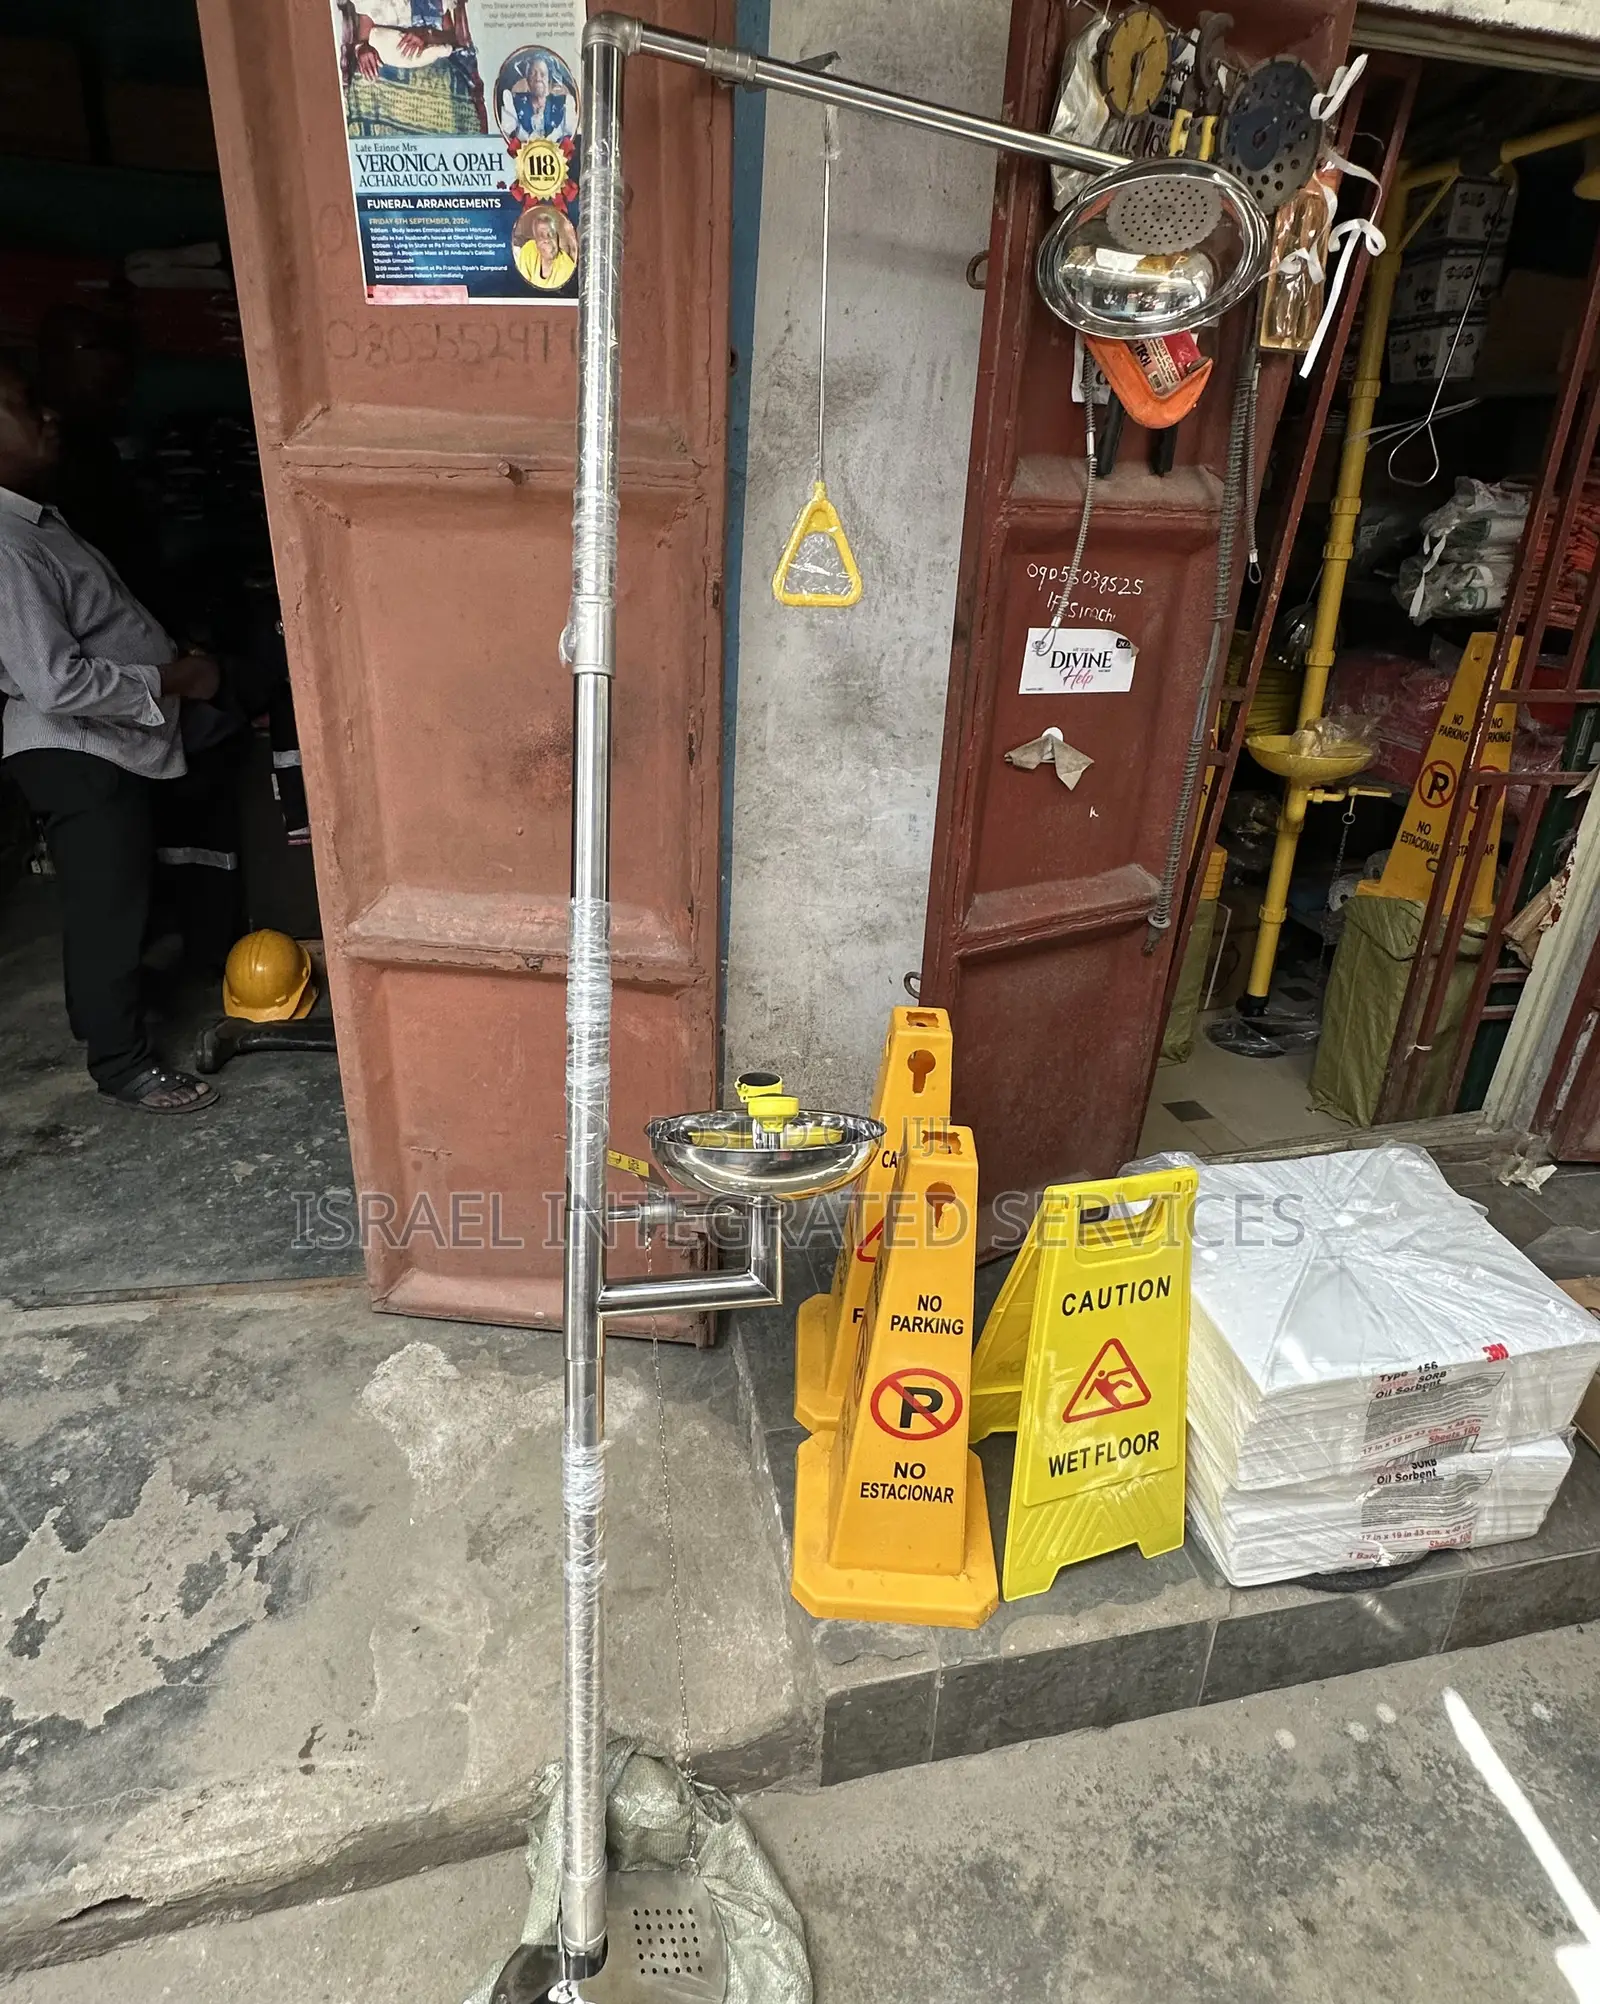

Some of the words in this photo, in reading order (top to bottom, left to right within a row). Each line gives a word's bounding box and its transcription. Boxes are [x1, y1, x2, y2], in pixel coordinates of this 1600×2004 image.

[536, 30, 552, 38] grand
[355, 143, 372, 152] Late
[374, 143, 400, 152] Ezinne
[402, 143, 418, 152] Mrs
[356, 153, 450, 173] VERONICA
[453, 153, 504, 172] OPAH
[529, 155, 556, 176] 118
[359, 174, 438, 187] ACHARAUGO
[441, 174, 492, 187] NWANYI
[367, 199, 414, 210] FUNERAL
[416, 198, 501, 209] ARRANGEMENTS
[1050, 650, 1112, 668] DIVINE
[1060, 665, 1094, 690] Help
[1452, 714, 1464, 725] NO
[1492, 718, 1503, 728] NO
[1438, 725, 1471, 743] PARKING
[1488, 732, 1512, 743] RKING
[1416, 820, 1432, 836] NO
[1400, 831, 1440, 854] ESTACIONAR
[917, 1294, 942, 1314] NO
[1062, 1275, 1171, 1316] CAUTION
[890, 1314, 964, 1336] PARKING
[1482, 1343, 1509, 1362] 3M
[1380, 1371, 1408, 1382] Type
[1417, 1361, 1438, 1372] 156
[1376, 1390, 1392, 1398] Oil
[1395, 1379, 1442, 1395] Sorbent
[1428, 1432, 1460, 1444] Sheets
[1463, 1426, 1481, 1436] 100
[1048, 1446, 1091, 1478] WET
[1094, 1430, 1160, 1466] FLOOR
[894, 1461, 926, 1480] NO
[1376, 1475, 1392, 1485] Oil
[1395, 1468, 1437, 1482] Sorbent
[860, 1482, 954, 1504] ESTACIONAR
[1428, 1538, 1457, 1550] Sheets
